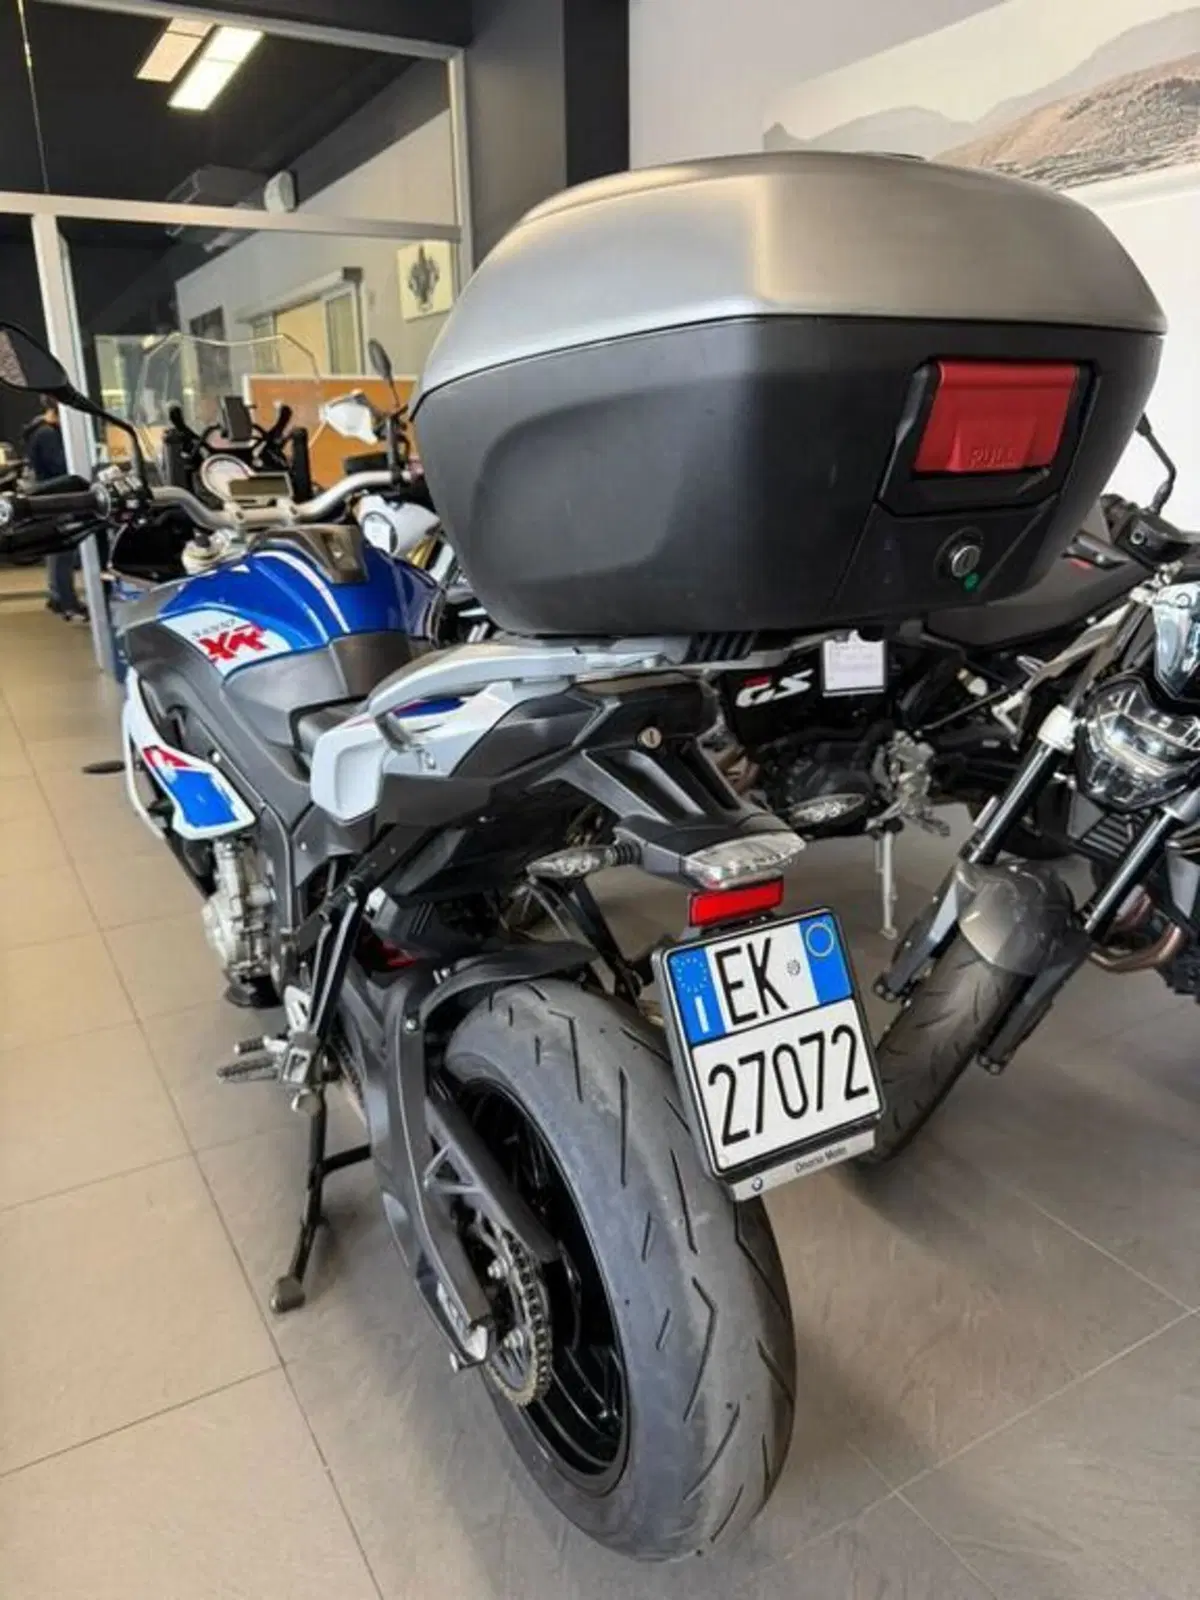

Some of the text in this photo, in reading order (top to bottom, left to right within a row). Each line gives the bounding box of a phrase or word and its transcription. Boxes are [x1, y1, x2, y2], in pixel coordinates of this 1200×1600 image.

[735, 668, 814, 707] GS
[714, 937, 788, 1025] EK
[708, 1024, 869, 1146] 27072
